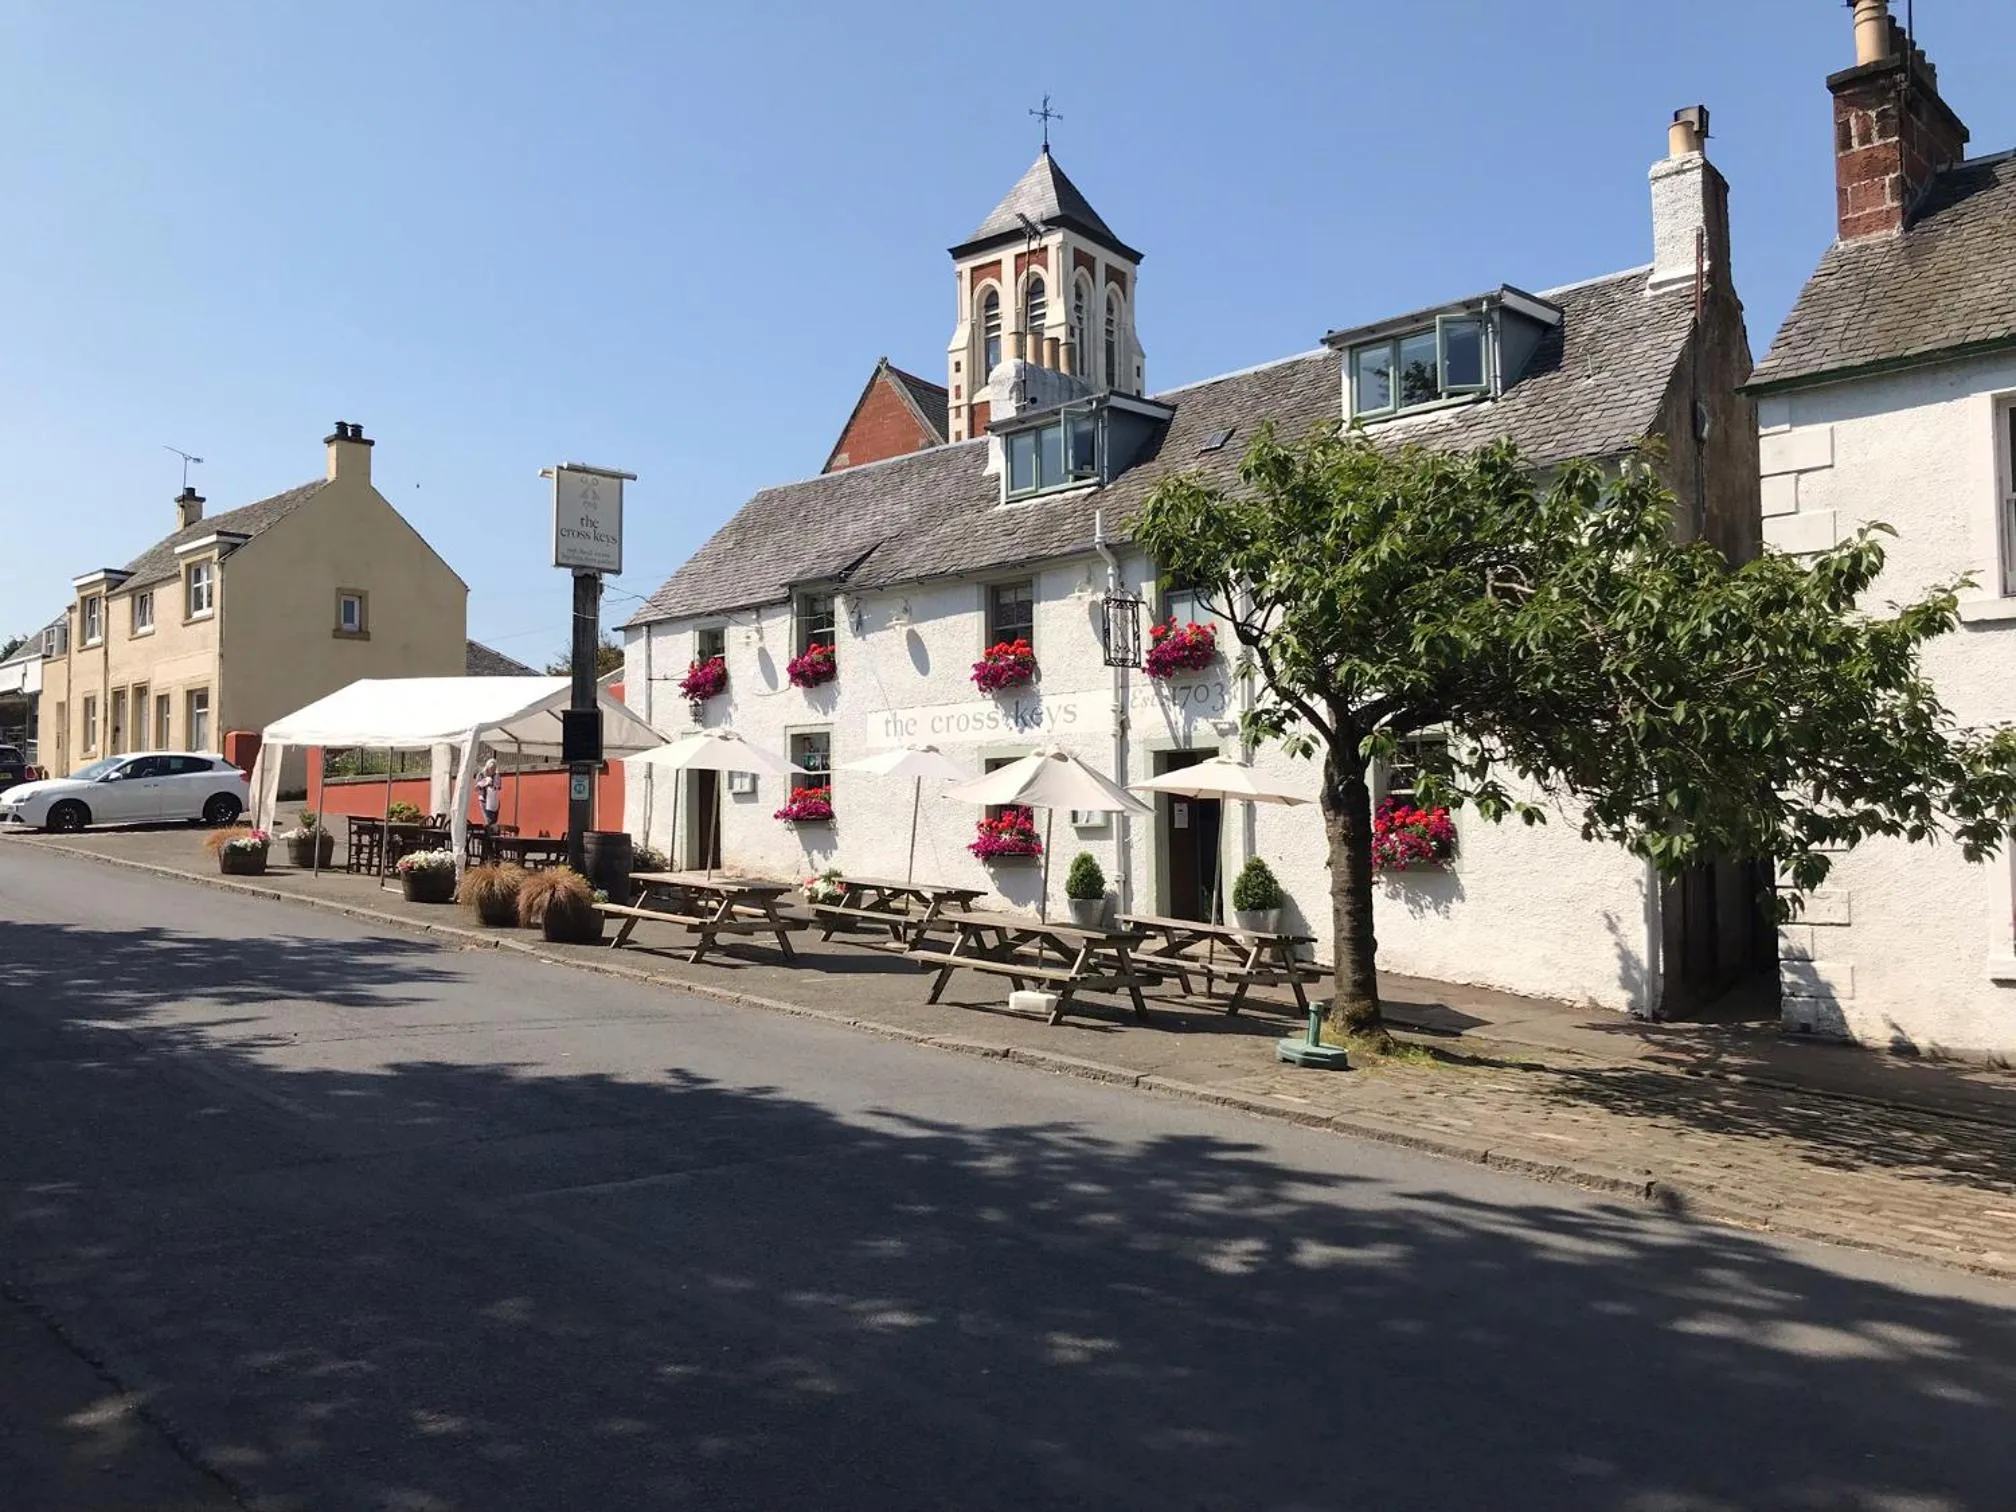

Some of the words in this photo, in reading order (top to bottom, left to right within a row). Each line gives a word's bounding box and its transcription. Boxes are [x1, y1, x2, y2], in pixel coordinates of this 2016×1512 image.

[580, 514, 600, 529] the
[560, 527, 592, 541] cross
[593, 529, 618, 547] keys
[1171, 681, 1226, 712] 1703
[884, 711, 917, 738] the
[931, 710, 1000, 734] cross
[1014, 699, 1078, 733] keys
